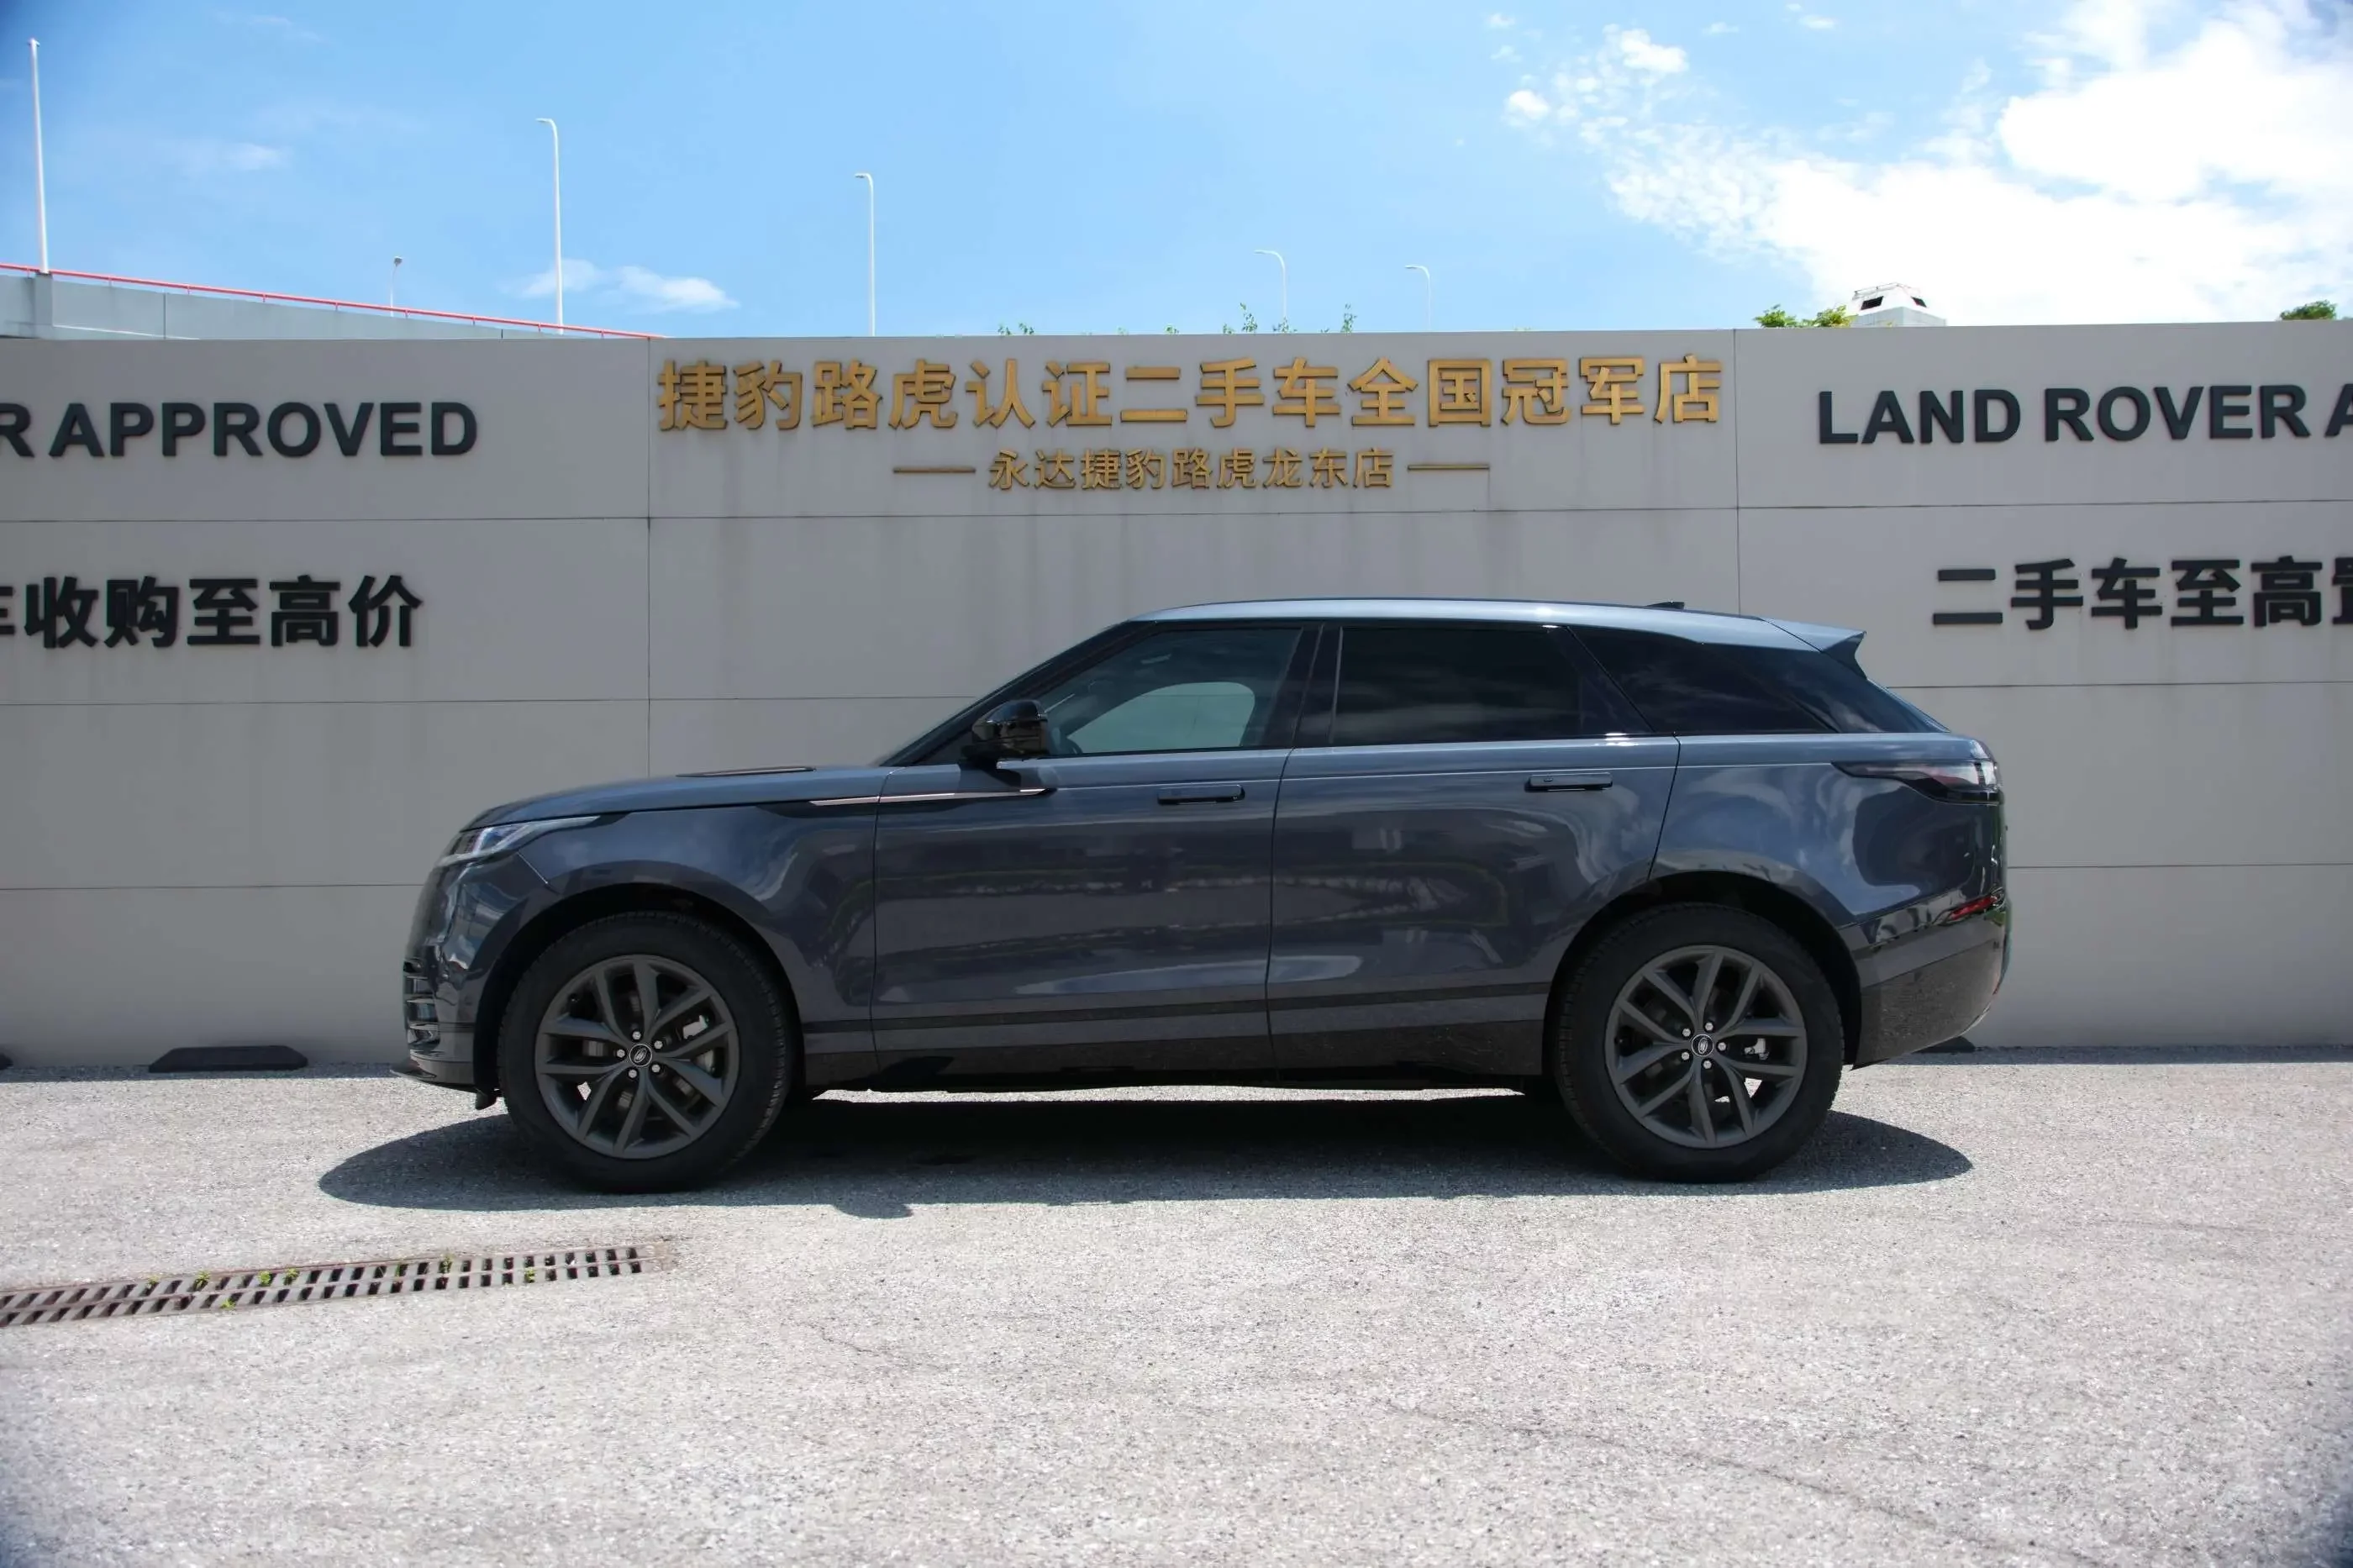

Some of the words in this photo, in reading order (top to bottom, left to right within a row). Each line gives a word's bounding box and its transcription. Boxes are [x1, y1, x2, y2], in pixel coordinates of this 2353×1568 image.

[658, 353, 1721, 430] 捷豹路虎认证二手车全国冠军店
[1819, 389, 2020, 444] LAND
[2045, 384, 2311, 442] ROVER
[49, 402, 477, 457] APPROVED
[989, 447, 1393, 490] 永达捷豹路虎龙东店
[0, 575, 422, 649] 收购至高价
